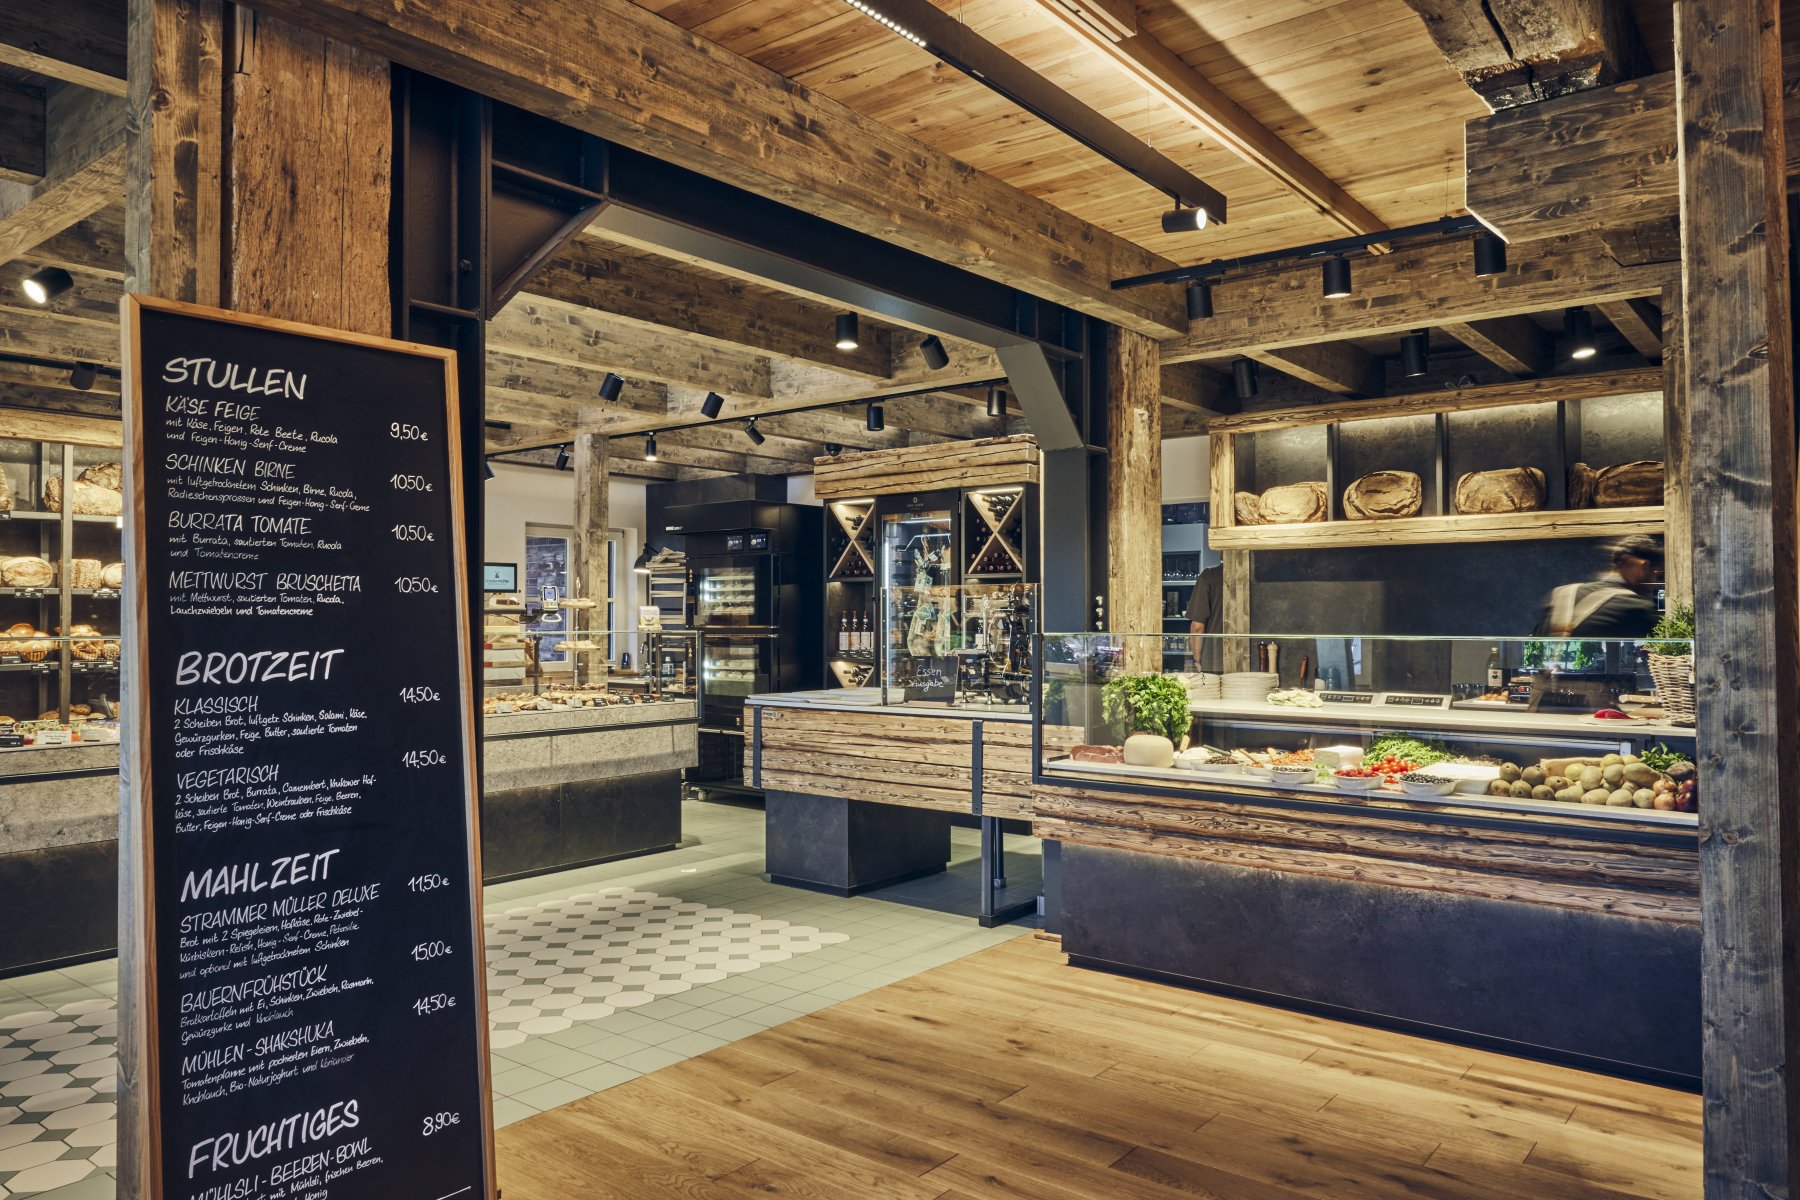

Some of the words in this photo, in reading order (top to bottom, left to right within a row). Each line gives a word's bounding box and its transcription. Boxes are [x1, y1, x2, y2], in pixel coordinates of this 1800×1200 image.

[163, 357, 307, 400] STULLEN
[166, 395, 210, 415] KÄSE
[215, 401, 261, 421] FEIGE
[167, 417, 183, 427] mit
[214, 420, 247, 435] Feigen,
[250, 423, 270, 437] Rote
[276, 426, 308, 442] Beete,
[311, 431, 338, 444] Rucola
[167, 431, 186, 441] und
[391, 422, 429, 441] 9,50€
[166, 453, 247, 476] SCHINKEN
[255, 460, 296, 480] BIRNE
[168, 475, 183, 485] mit
[188, 475, 256, 491] luftgetrocknetem
[260, 480, 301, 495] Schinken,
[304, 483, 327, 497] Birne,
[330, 486, 357, 500] Rucola,
[169, 487, 256, 504] Radieschensprossen
[258, 496, 275, 505] und
[169, 510, 243, 532] BURRATA
[251, 515, 312, 535] TOMATE
[170, 533, 187, 543] mit
[193, 533, 231, 547] Burrata,
[234, 536, 277, 547] sautierten
[280, 537, 315, 550] Tomaten,
[318, 539, 342, 550] Rucola
[171, 549, 189, 558] und
[195, 548, 259, 560] Tomatencreme
[170, 570, 269, 590] METTWURST
[277, 572, 362, 592] BRUSCHETTA
[170, 593, 187, 603] mit
[191, 592, 235, 604] Mettwurst,
[237, 594, 277, 603] sautierten
[280, 592, 315, 604] Tomaten,
[317, 593, 345, 605] Rucola,
[171, 605, 233, 616] Lauchzwiebeln
[236, 606, 253, 616] und
[256, 605, 314, 616] Tomatencreme
[176, 648, 345, 686] BROTZEIT
[916, 664, 942, 677] Essen
[400, 686, 441, 704] 14,50€
[912, 679, 944, 692] Ausgabe
[175, 695, 259, 716] KLASSISCH
[173, 718, 181, 730] 2
[184, 717, 222, 729] Scheiben
[226, 715, 246, 726] Brot,
[283, 712, 317, 723] Schinken,
[319, 709, 348, 720] Salami,
[175, 730, 239, 746] Gewürzgurken,
[265, 726, 291, 738] Butter,
[292, 724, 325, 736] sautierte
[328, 722, 358, 734] Tomaten
[176, 747, 196, 758] oder
[199, 743, 244, 756] Frischkäse
[402, 749, 447, 769] 14,50€
[178, 763, 280, 790] VEGETARISCH
[175, 794, 182, 806] 2
[185, 792, 220, 804] Scheiben
[224, 788, 244, 800] Brot,
[247, 784, 281, 798] Burrata,
[283, 779, 329, 793] Camembert,
[363, 774, 377, 786] Hof-
[176, 808, 195, 820] käse,
[197, 804, 228, 817] sautierte
[232, 800, 266, 812] Tomaten,
[267, 795, 314, 809] Weintrauben,
[337, 791, 362, 801] Beeren,
[176, 822, 202, 834] Butter,
[300, 809, 315, 819] oder
[317, 805, 352, 817] Frischkäse
[181, 848, 340, 903] MAHLZEIT
[408, 873, 450, 893] 11,50€
[181, 902, 268, 934] STRAMMER
[273, 891, 327, 917] MÜLLER
[332, 882, 381, 907] DELUXE
[180, 935, 200, 949] Brot
[203, 932, 219, 945] mit
[221, 930, 228, 942] 2
[231, 924, 280, 941] Spiegeleiern,
[181, 939, 257, 963] Kürbiskern-Relish,
[330, 921, 360, 935] Petersilie
[180, 967, 197, 980] und
[200, 960, 232, 978] optional
[234, 956, 248, 968] mit
[252, 945, 311, 967] luftgetrocknetem
[315, 936, 350, 952] Schinken
[412, 940, 453, 962] 15,00€
[181, 963, 328, 1014] BAUERNFRÜHSTÜCK
[181, 1006, 237, 1028] Bratkartoffeln
[240, 1002, 254, 1014] mit
[269, 992, 305, 1007] Schinken,
[413, 993, 457, 1016] 14,50€
[182, 1022, 233, 1046] Gewürzgurke
[236, 1017, 251, 1029] und
[257, 1007, 294, 1024] Knoblauch
[182, 1020, 334, 1076] MÜHLEN-SHAKSHUKA
[182, 1067, 246, 1090] Tomatenpfanne
[249, 1059, 265, 1074] mit
[269, 1050, 308, 1070] pochierten
[311, 1045, 333, 1057] Eiern,
[183, 1085, 228, 1106] Knoblauch,
[230, 1065, 299, 1093] Bio-Naturjoghurt
[303, 1060, 318, 1074] und
[423, 1111, 461, 1137] 8,90€
[189, 1098, 360, 1179] FRUCHTIGES
[270, 1187, 286, 1200] mit
[325, 1166, 354, 1184] frischen
[357, 1156, 384, 1170] Beeren,
